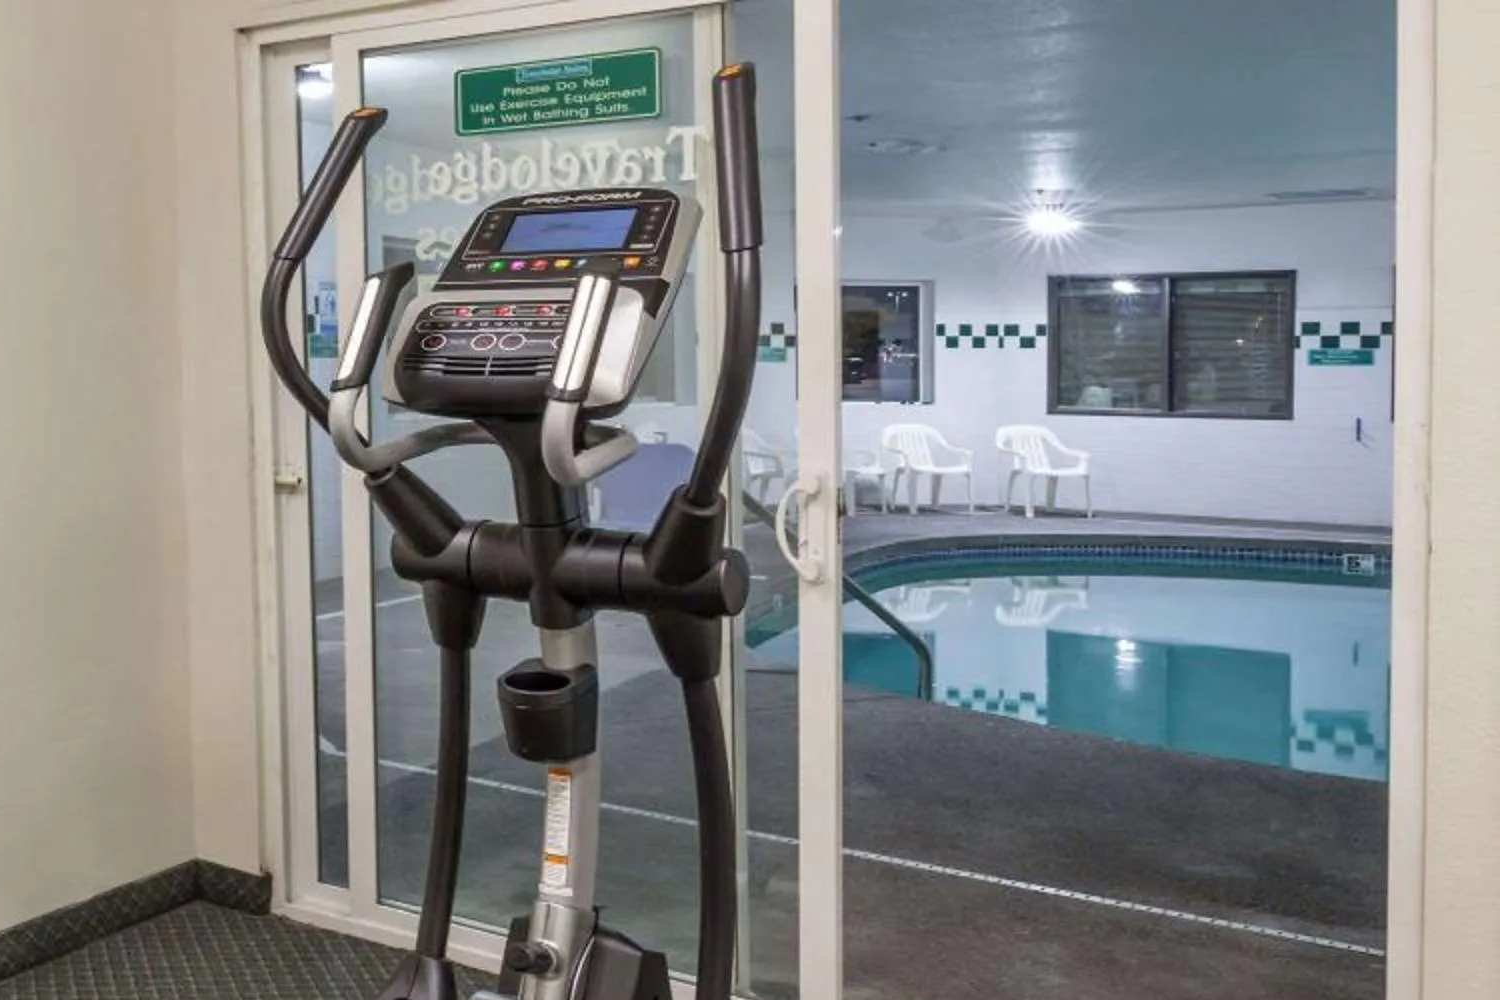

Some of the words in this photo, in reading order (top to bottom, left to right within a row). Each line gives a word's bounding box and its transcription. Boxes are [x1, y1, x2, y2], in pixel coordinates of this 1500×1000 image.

[503, 83, 550, 97] Please
[556, 80, 577, 92] Do
[583, 75, 610, 89] Not
[470, 102, 495, 113] Use
[500, 97, 558, 111] Exercise
[564, 85, 647, 106] Equipment
[501, 110, 527, 123] Wet
[533, 105, 589, 123] Bathing
